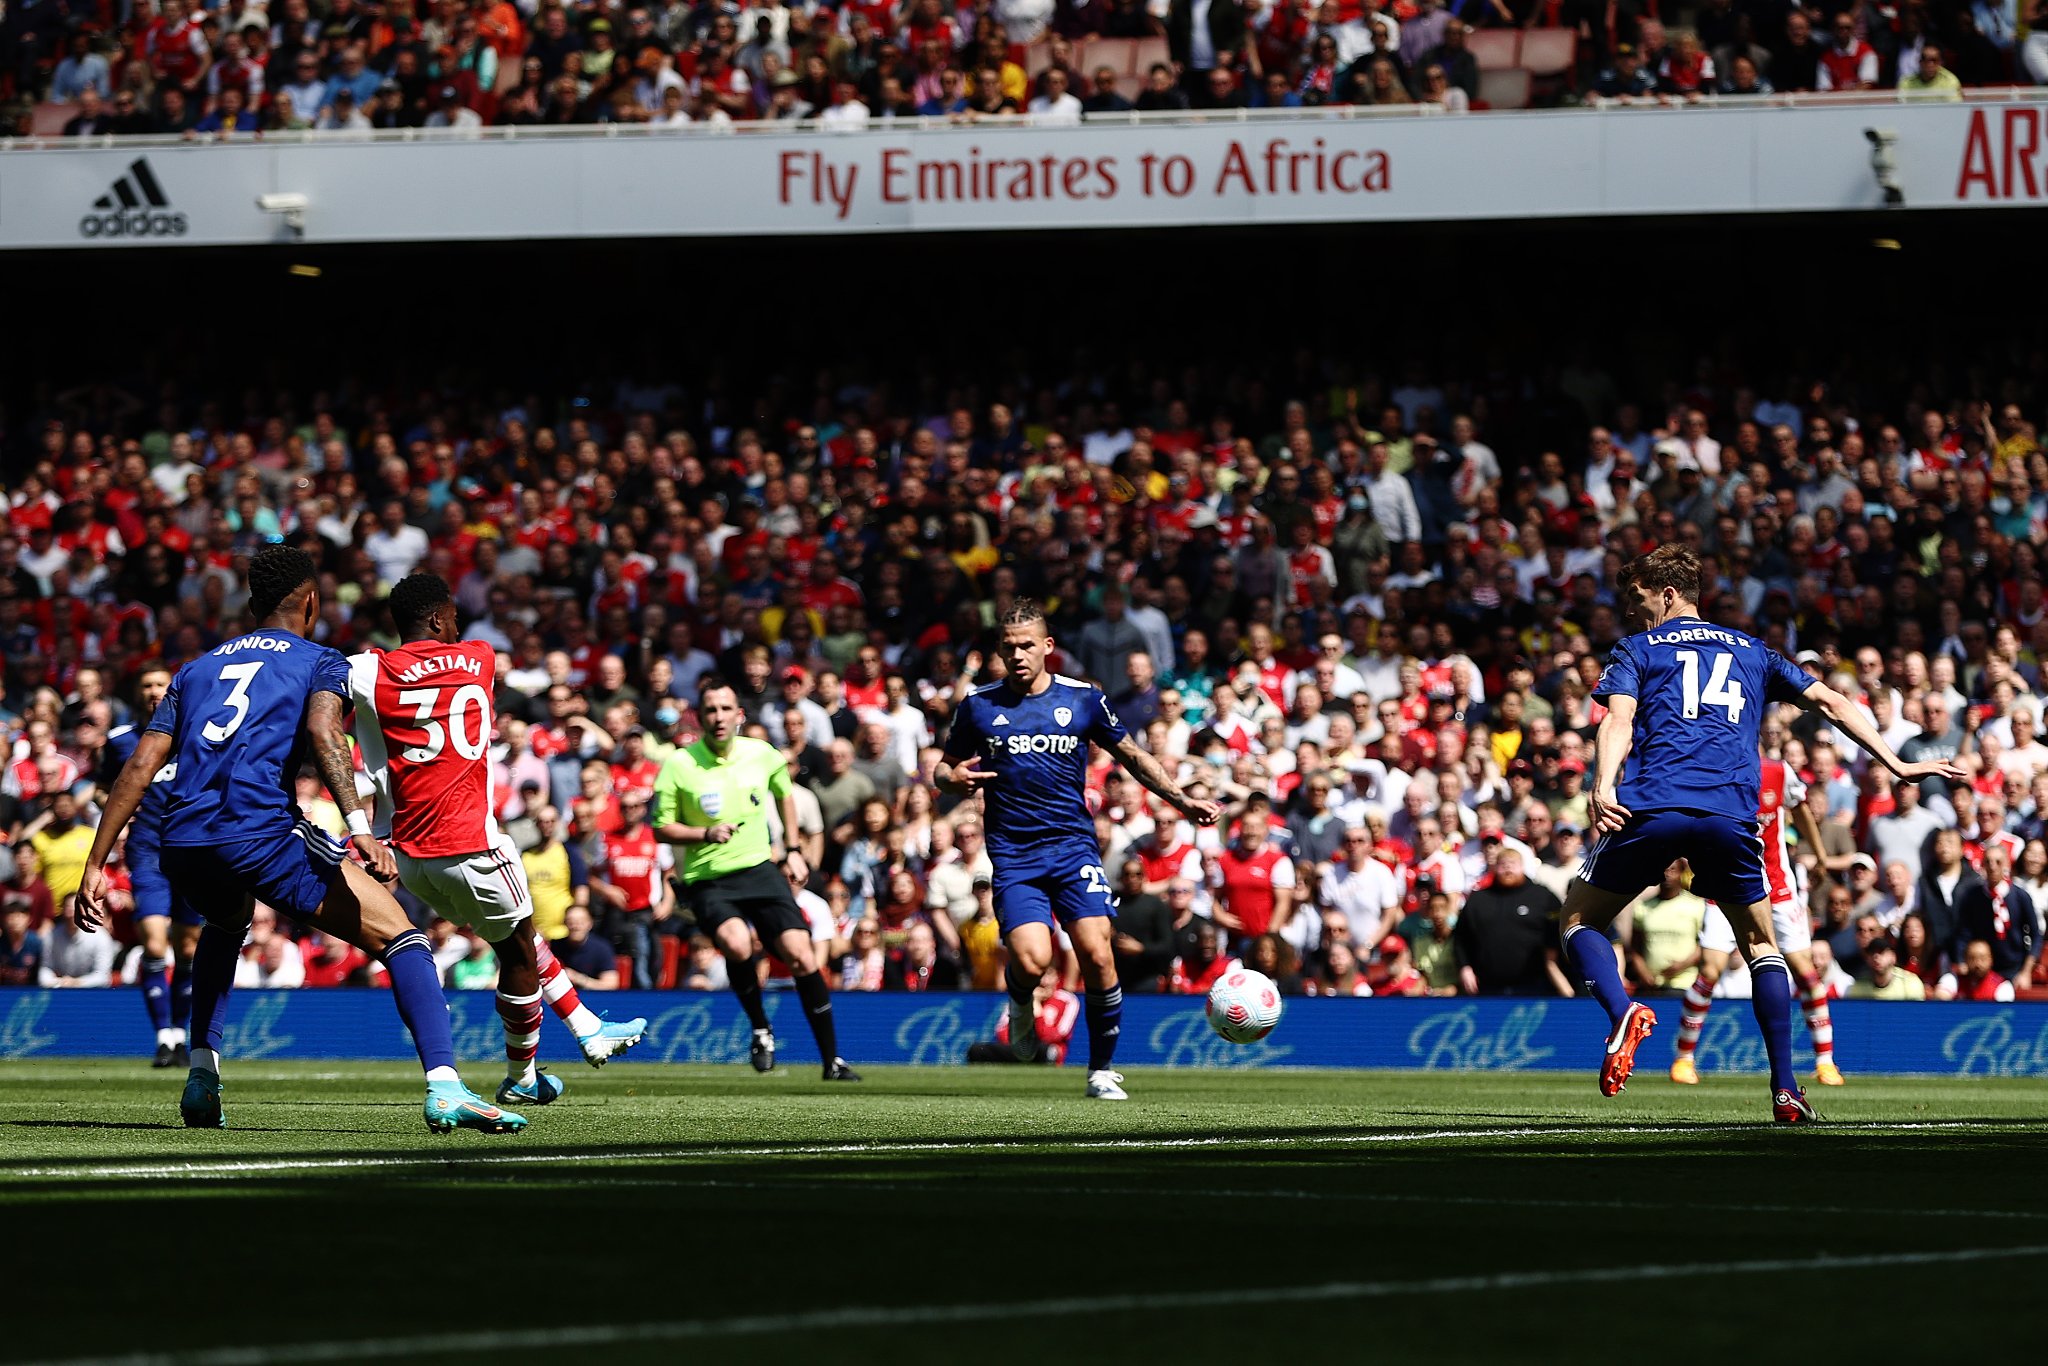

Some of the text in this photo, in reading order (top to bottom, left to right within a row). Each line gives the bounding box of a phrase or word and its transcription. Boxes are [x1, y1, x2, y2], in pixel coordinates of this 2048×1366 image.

[778, 137, 1392, 220] Fly Emirates to Africa
[1957, 106, 2048, 199] AR
[79, 208, 189, 238] adidas
[212, 635, 292, 657] JUNIOR
[398, 653, 482, 685] NKETIAH
[1646, 627, 1752, 649] LLORENTE R
[201, 660, 265, 743] 3
[398, 683, 491, 763] 30
[1675, 650, 1747, 725] 14
